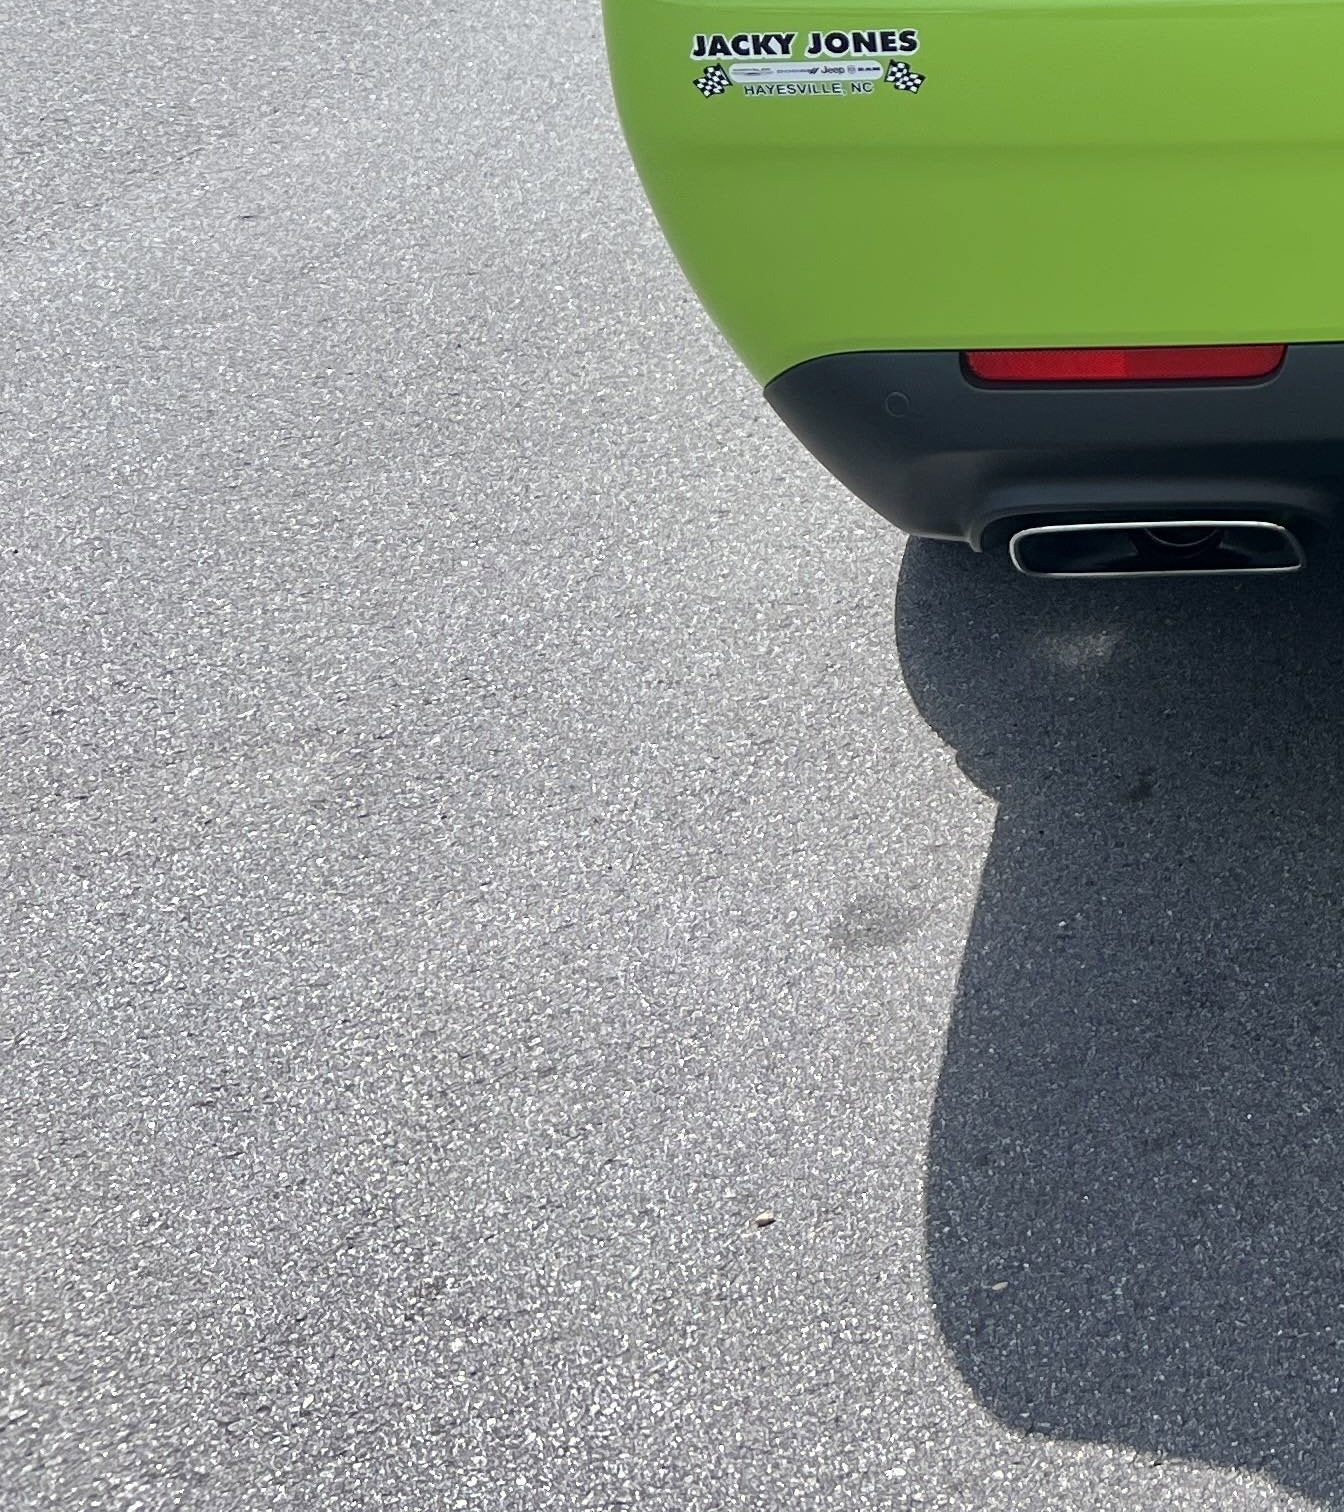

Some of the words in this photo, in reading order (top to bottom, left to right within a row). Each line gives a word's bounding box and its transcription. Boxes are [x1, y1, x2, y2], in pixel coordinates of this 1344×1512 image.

[692, 32, 796, 57] JACKY
[807, 30, 919, 55] JONES
[821, 66, 846, 75] Jeep
[744, 83, 846, 95] HAYESVILLE,
[851, 82, 873, 92] NC
